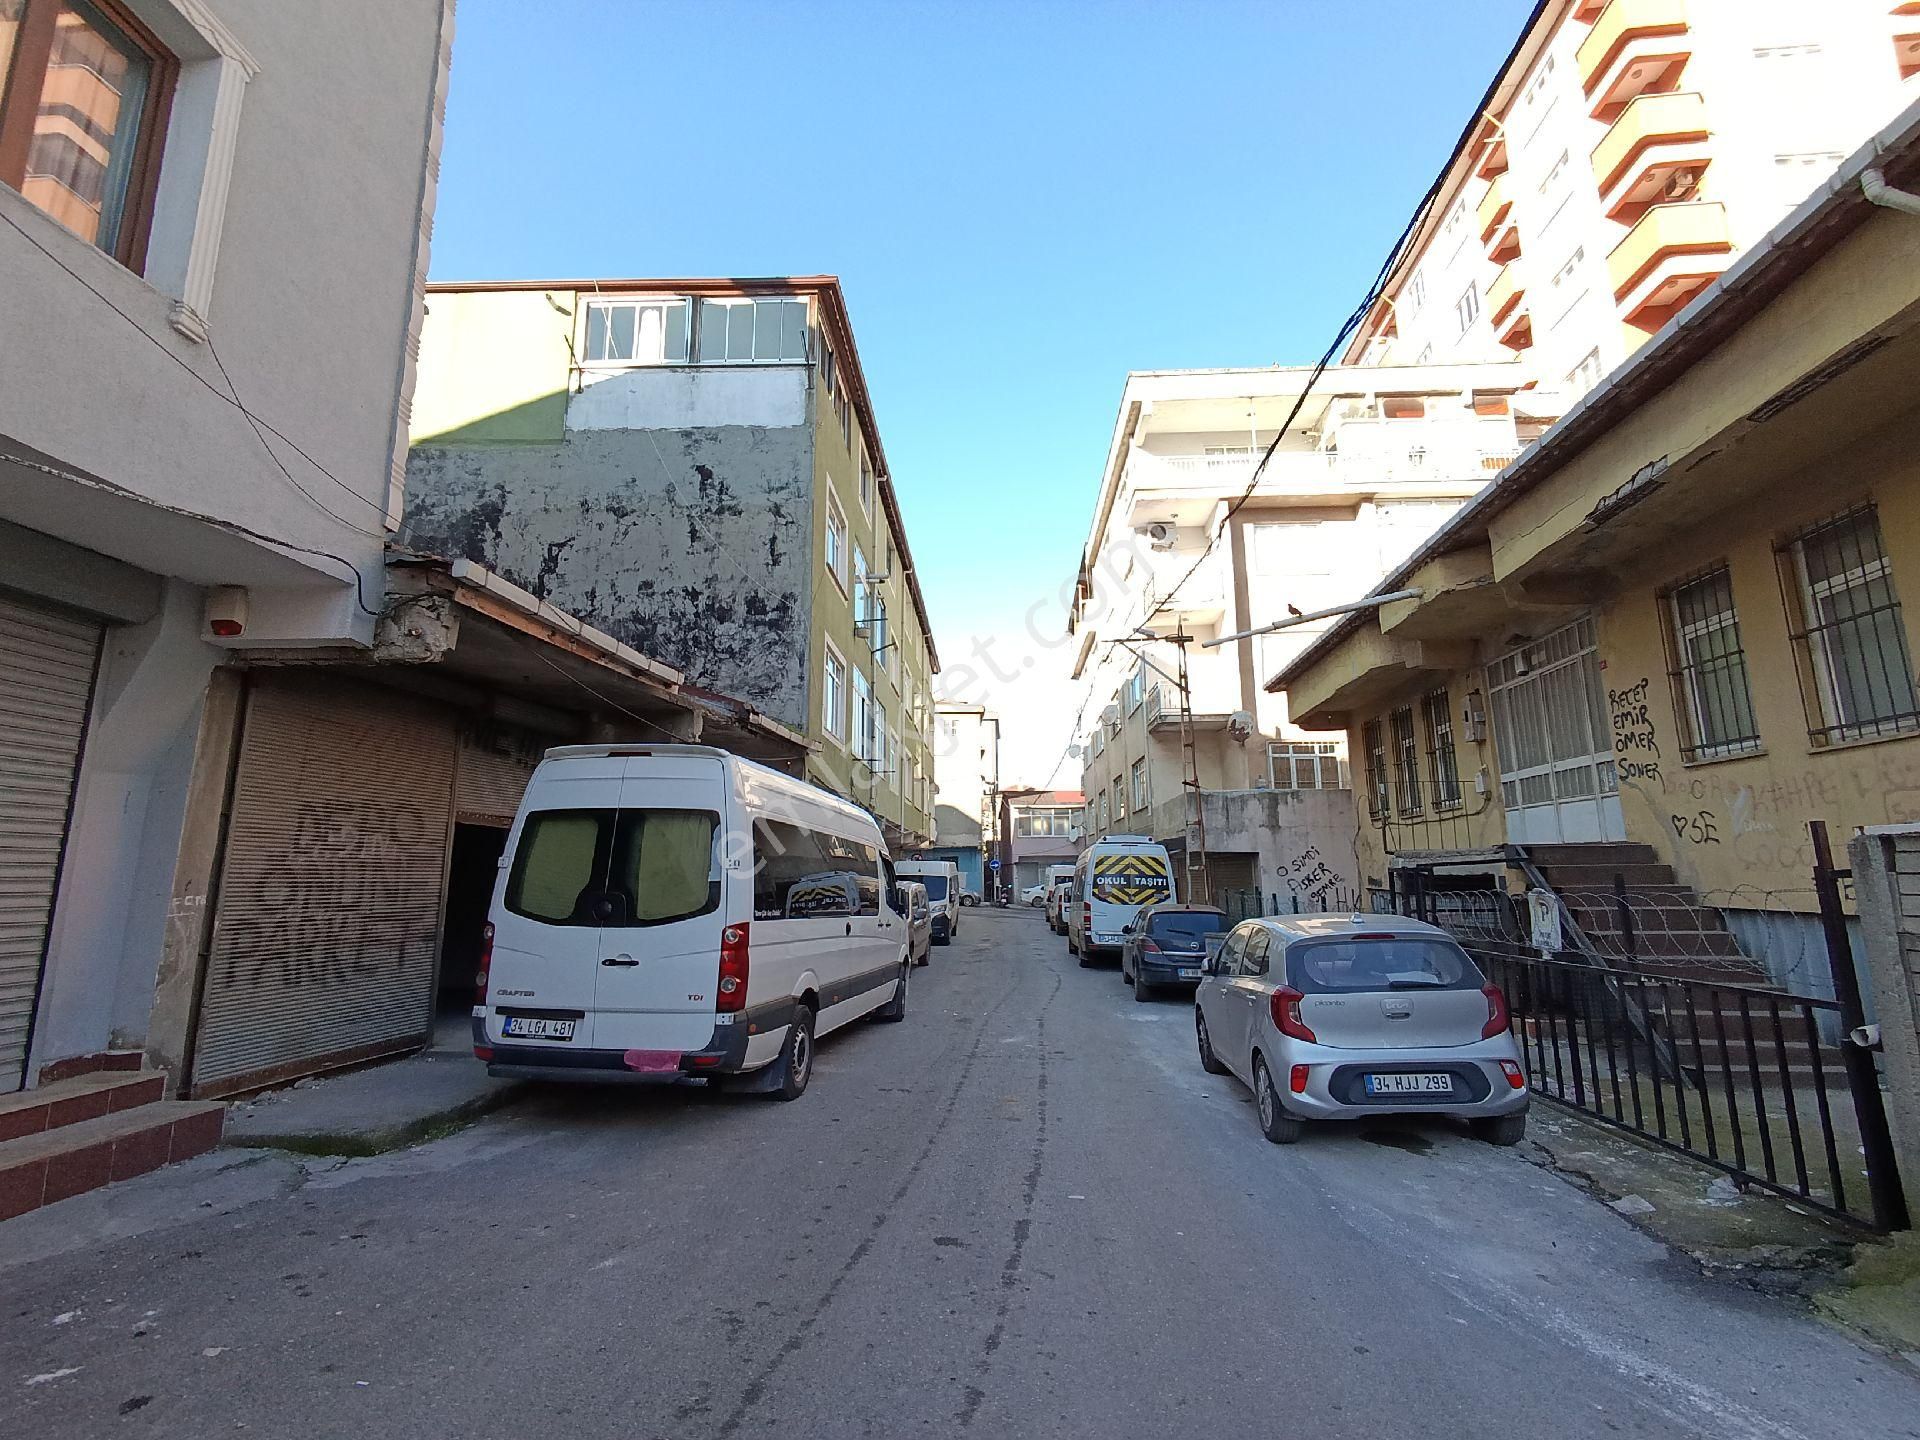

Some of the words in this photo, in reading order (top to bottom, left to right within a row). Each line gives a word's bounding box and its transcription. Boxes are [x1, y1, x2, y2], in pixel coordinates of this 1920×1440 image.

[1618, 757, 1666, 795] SONER
[1096, 876, 1128, 885] OKUL
[1133, 877, 1168, 887] TAŞITI
[496, 988, 535, 997] CRAFTER
[511, 1019, 523, 1032] 34
[527, 1020, 547, 1034] LGA
[552, 1022, 572, 1035] 481
[1374, 1077, 1390, 1091] 34
[1395, 1076, 1420, 1091] HJJ
[1424, 1075, 1449, 1091] 299
